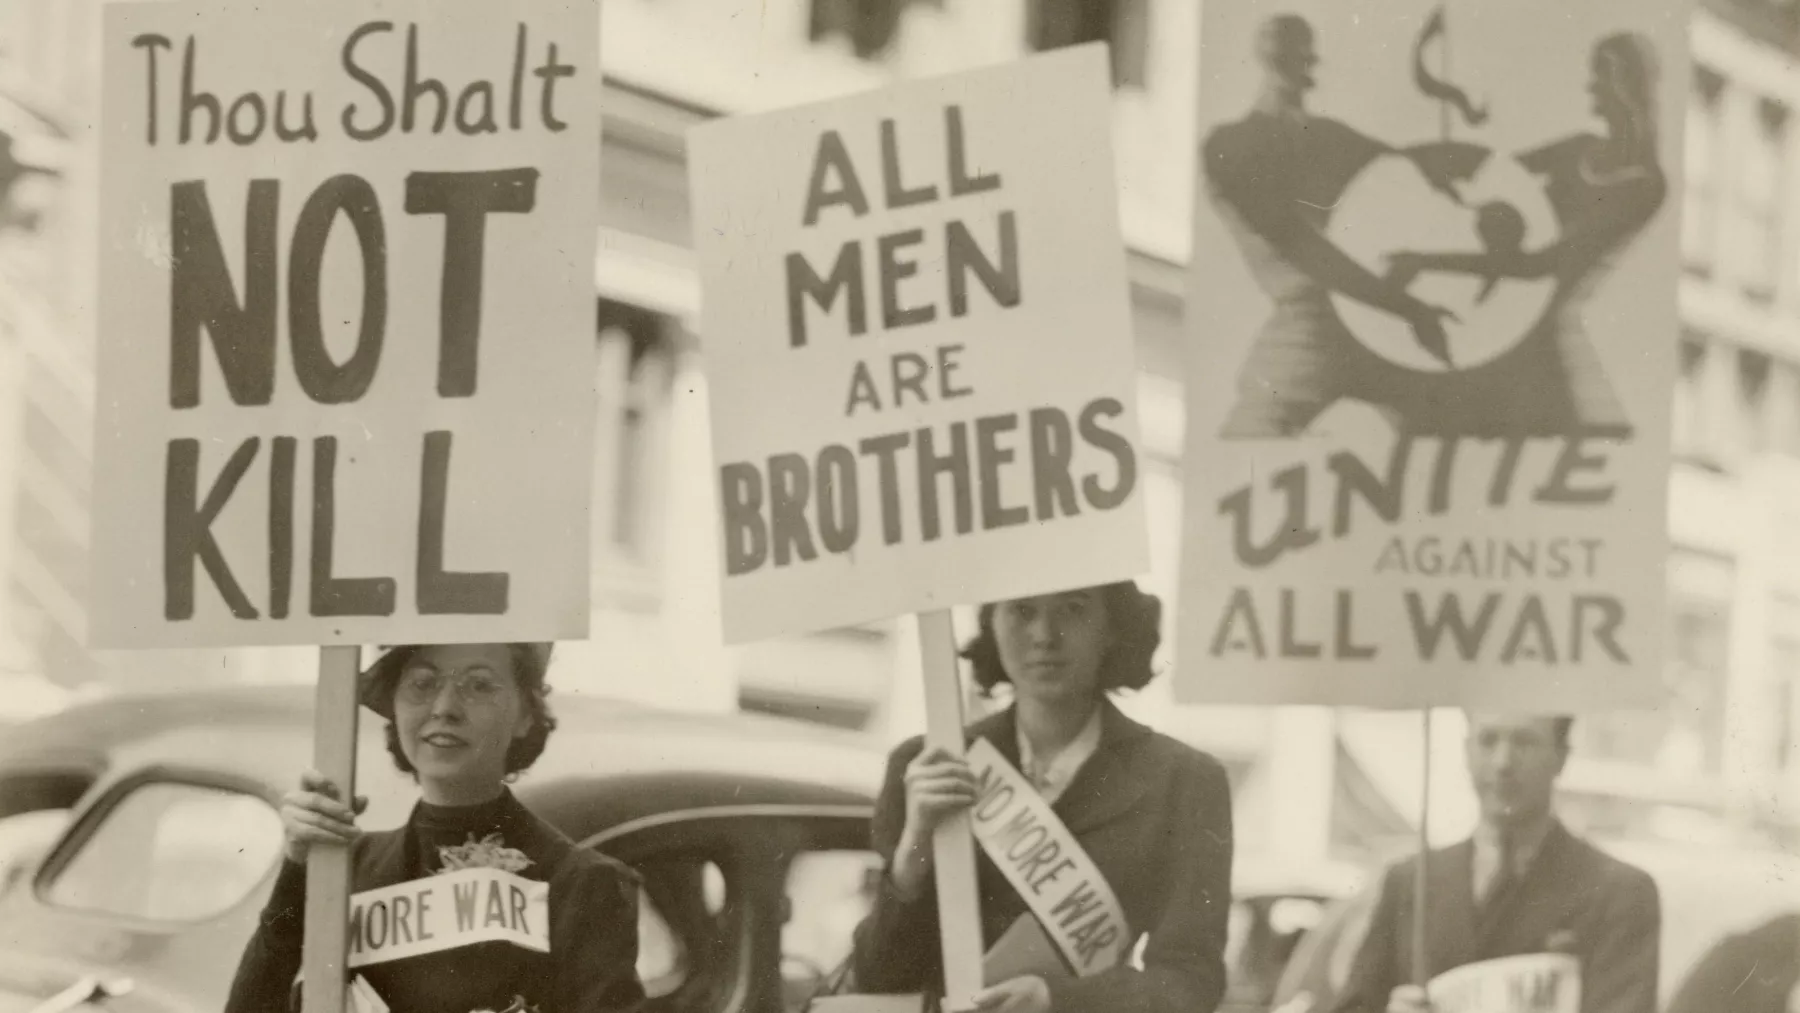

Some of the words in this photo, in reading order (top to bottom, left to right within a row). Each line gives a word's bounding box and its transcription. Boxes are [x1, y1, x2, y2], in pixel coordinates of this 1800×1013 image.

[131, 33, 317, 146] Thou
[341, 21, 576, 141] Shalt
[803, 105, 1001, 227] ALL
[169, 166, 541, 409] NOT
[785, 210, 1022, 348] MEN
[845, 344, 973, 417] ARE
[164, 429, 510, 621] KILL
[720, 397, 1137, 576] BROTHERS
[1217, 427, 1632, 569] UNITE
[1374, 537, 1604, 579] AGAINST
[1209, 588, 1379, 660] ALL
[1404, 592, 1632, 666] WAR
[453, 880, 529, 935] WAR
[976, 764, 1015, 822] NO
[1007, 806, 1077, 896] MORE
[1050, 880, 1118, 968] WAR
